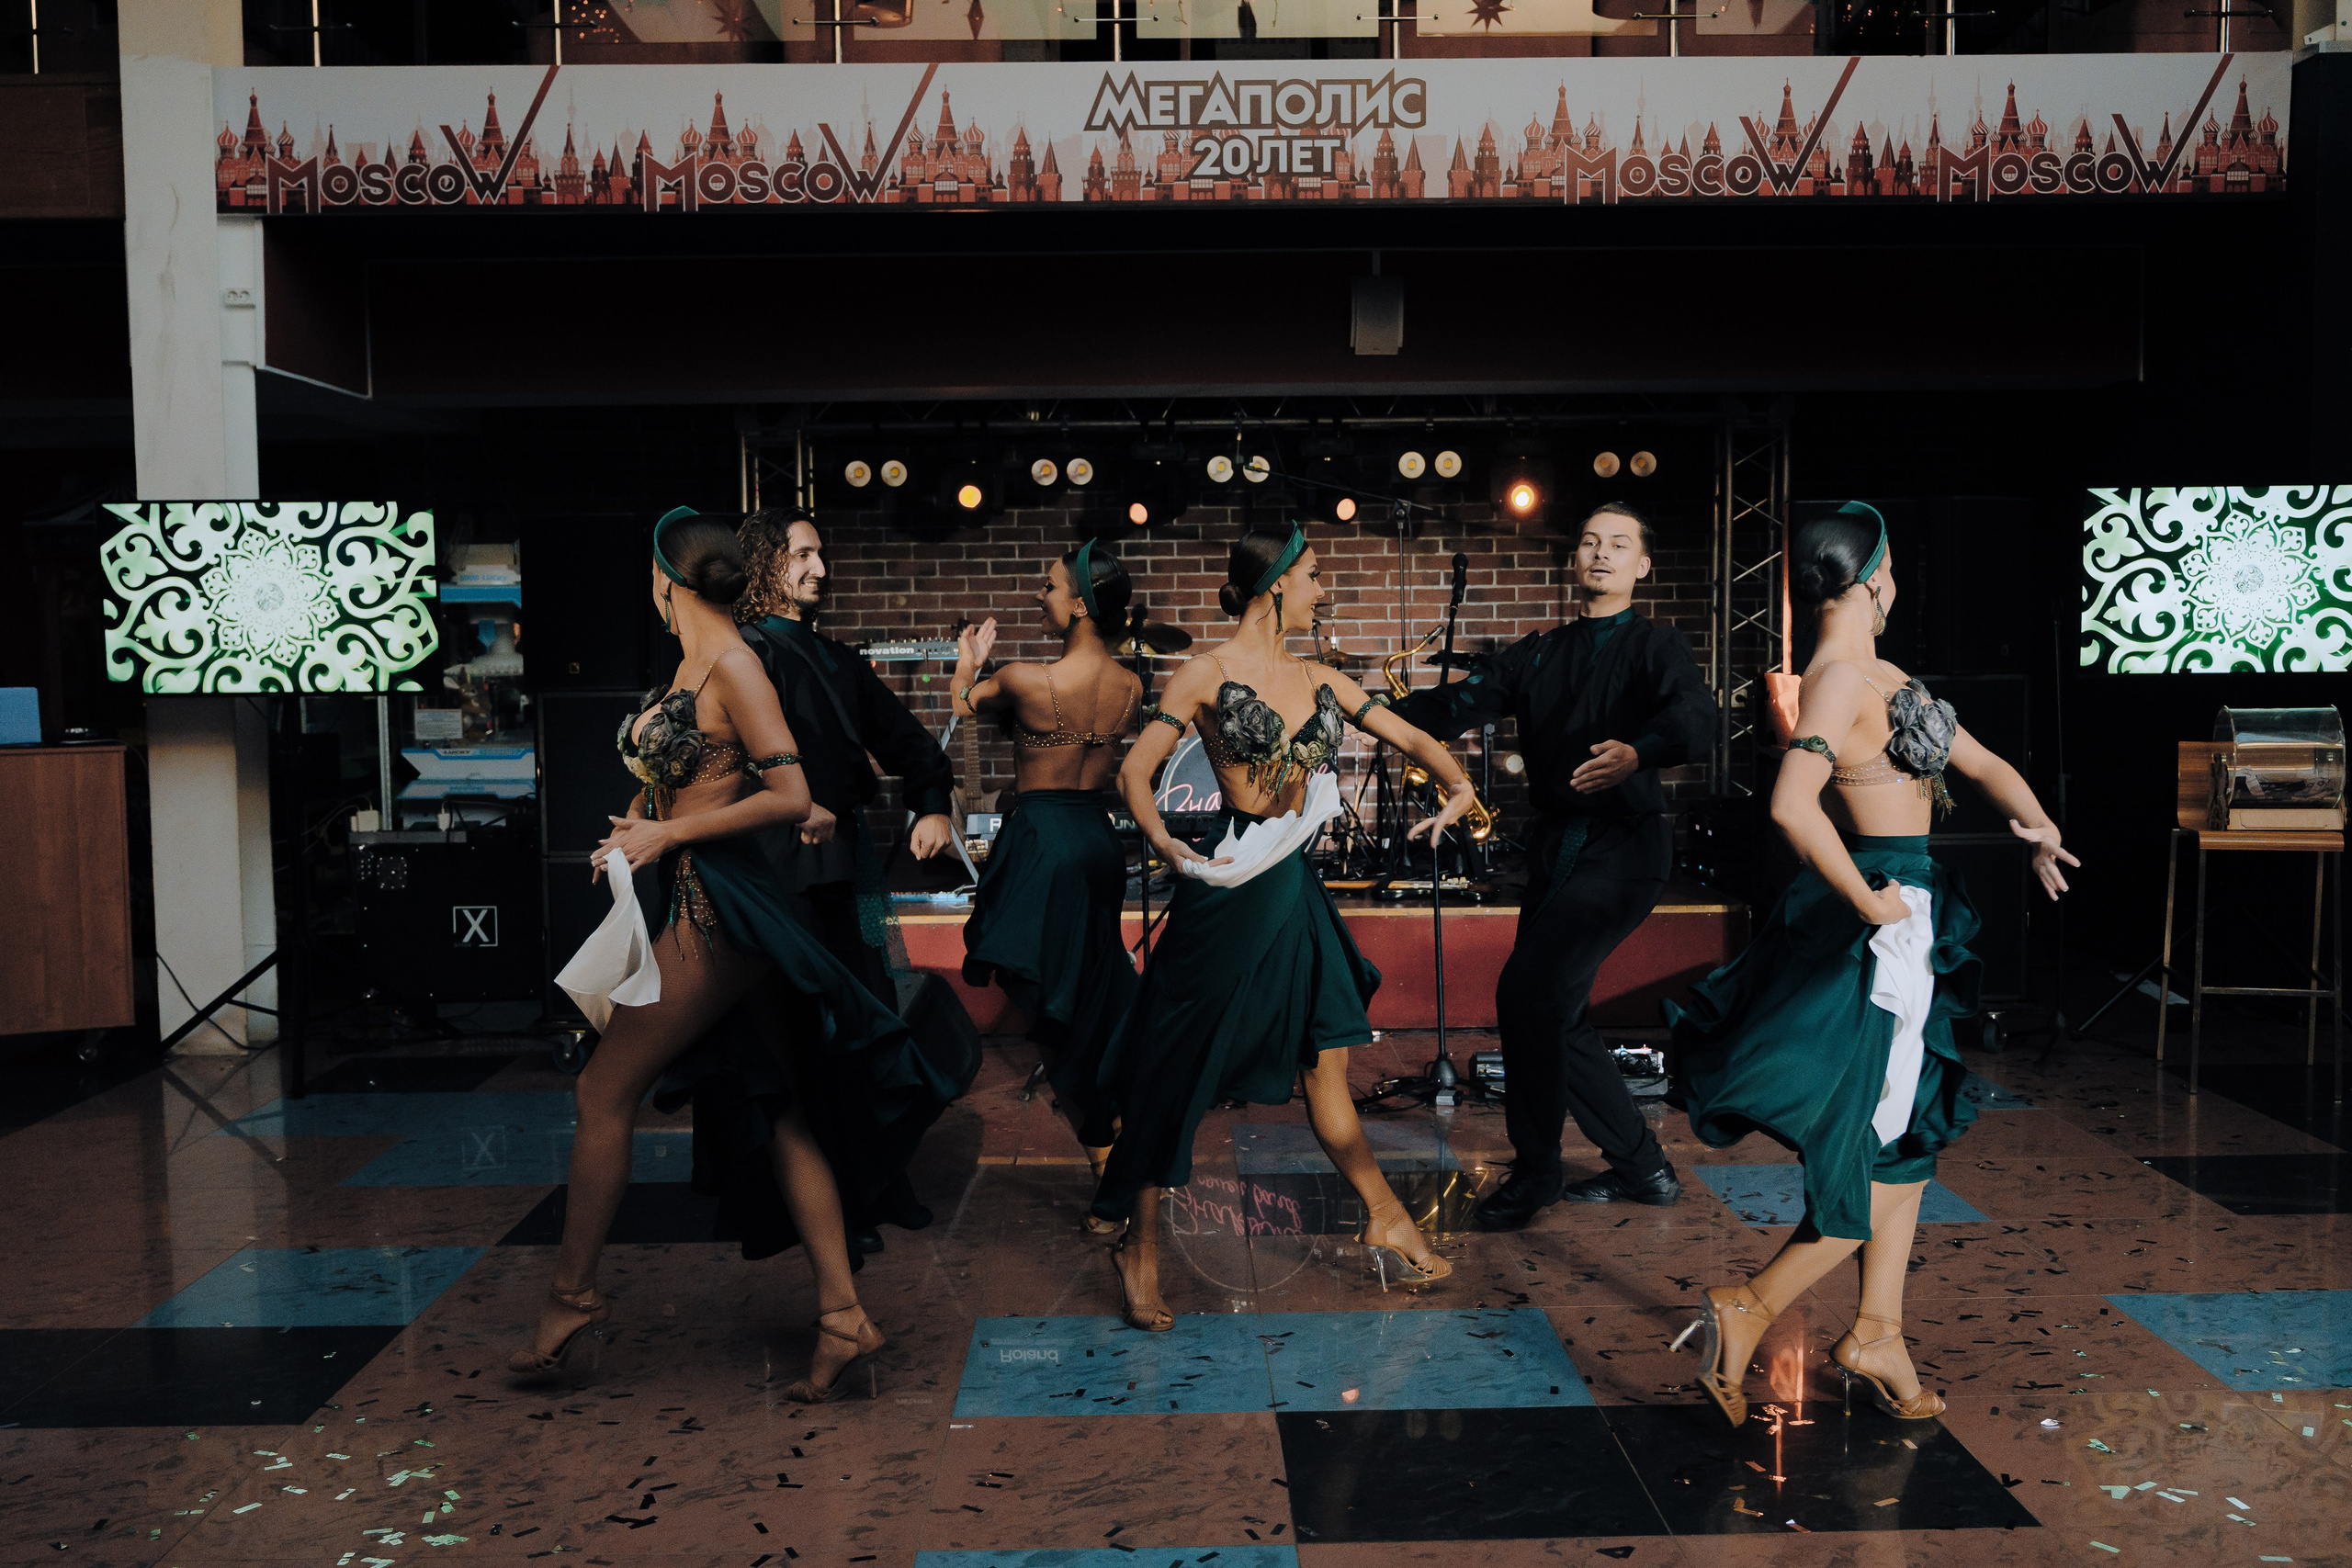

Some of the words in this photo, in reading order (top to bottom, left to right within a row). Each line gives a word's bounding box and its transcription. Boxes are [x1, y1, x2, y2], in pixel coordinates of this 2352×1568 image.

[266, 64, 561, 213] MOSCOW
[642, 62, 938, 212] MOSCOW
[1086, 69, 1425, 136] МЕГАПОЛИС
[1193, 139, 1250, 175] 20
[1256, 139, 1340, 175] ЛЕТ
[1564, 57, 1860, 205] MOSCOW
[1936, 53, 2235, 202] MOSCOW
[859, 646, 915, 656] novation
